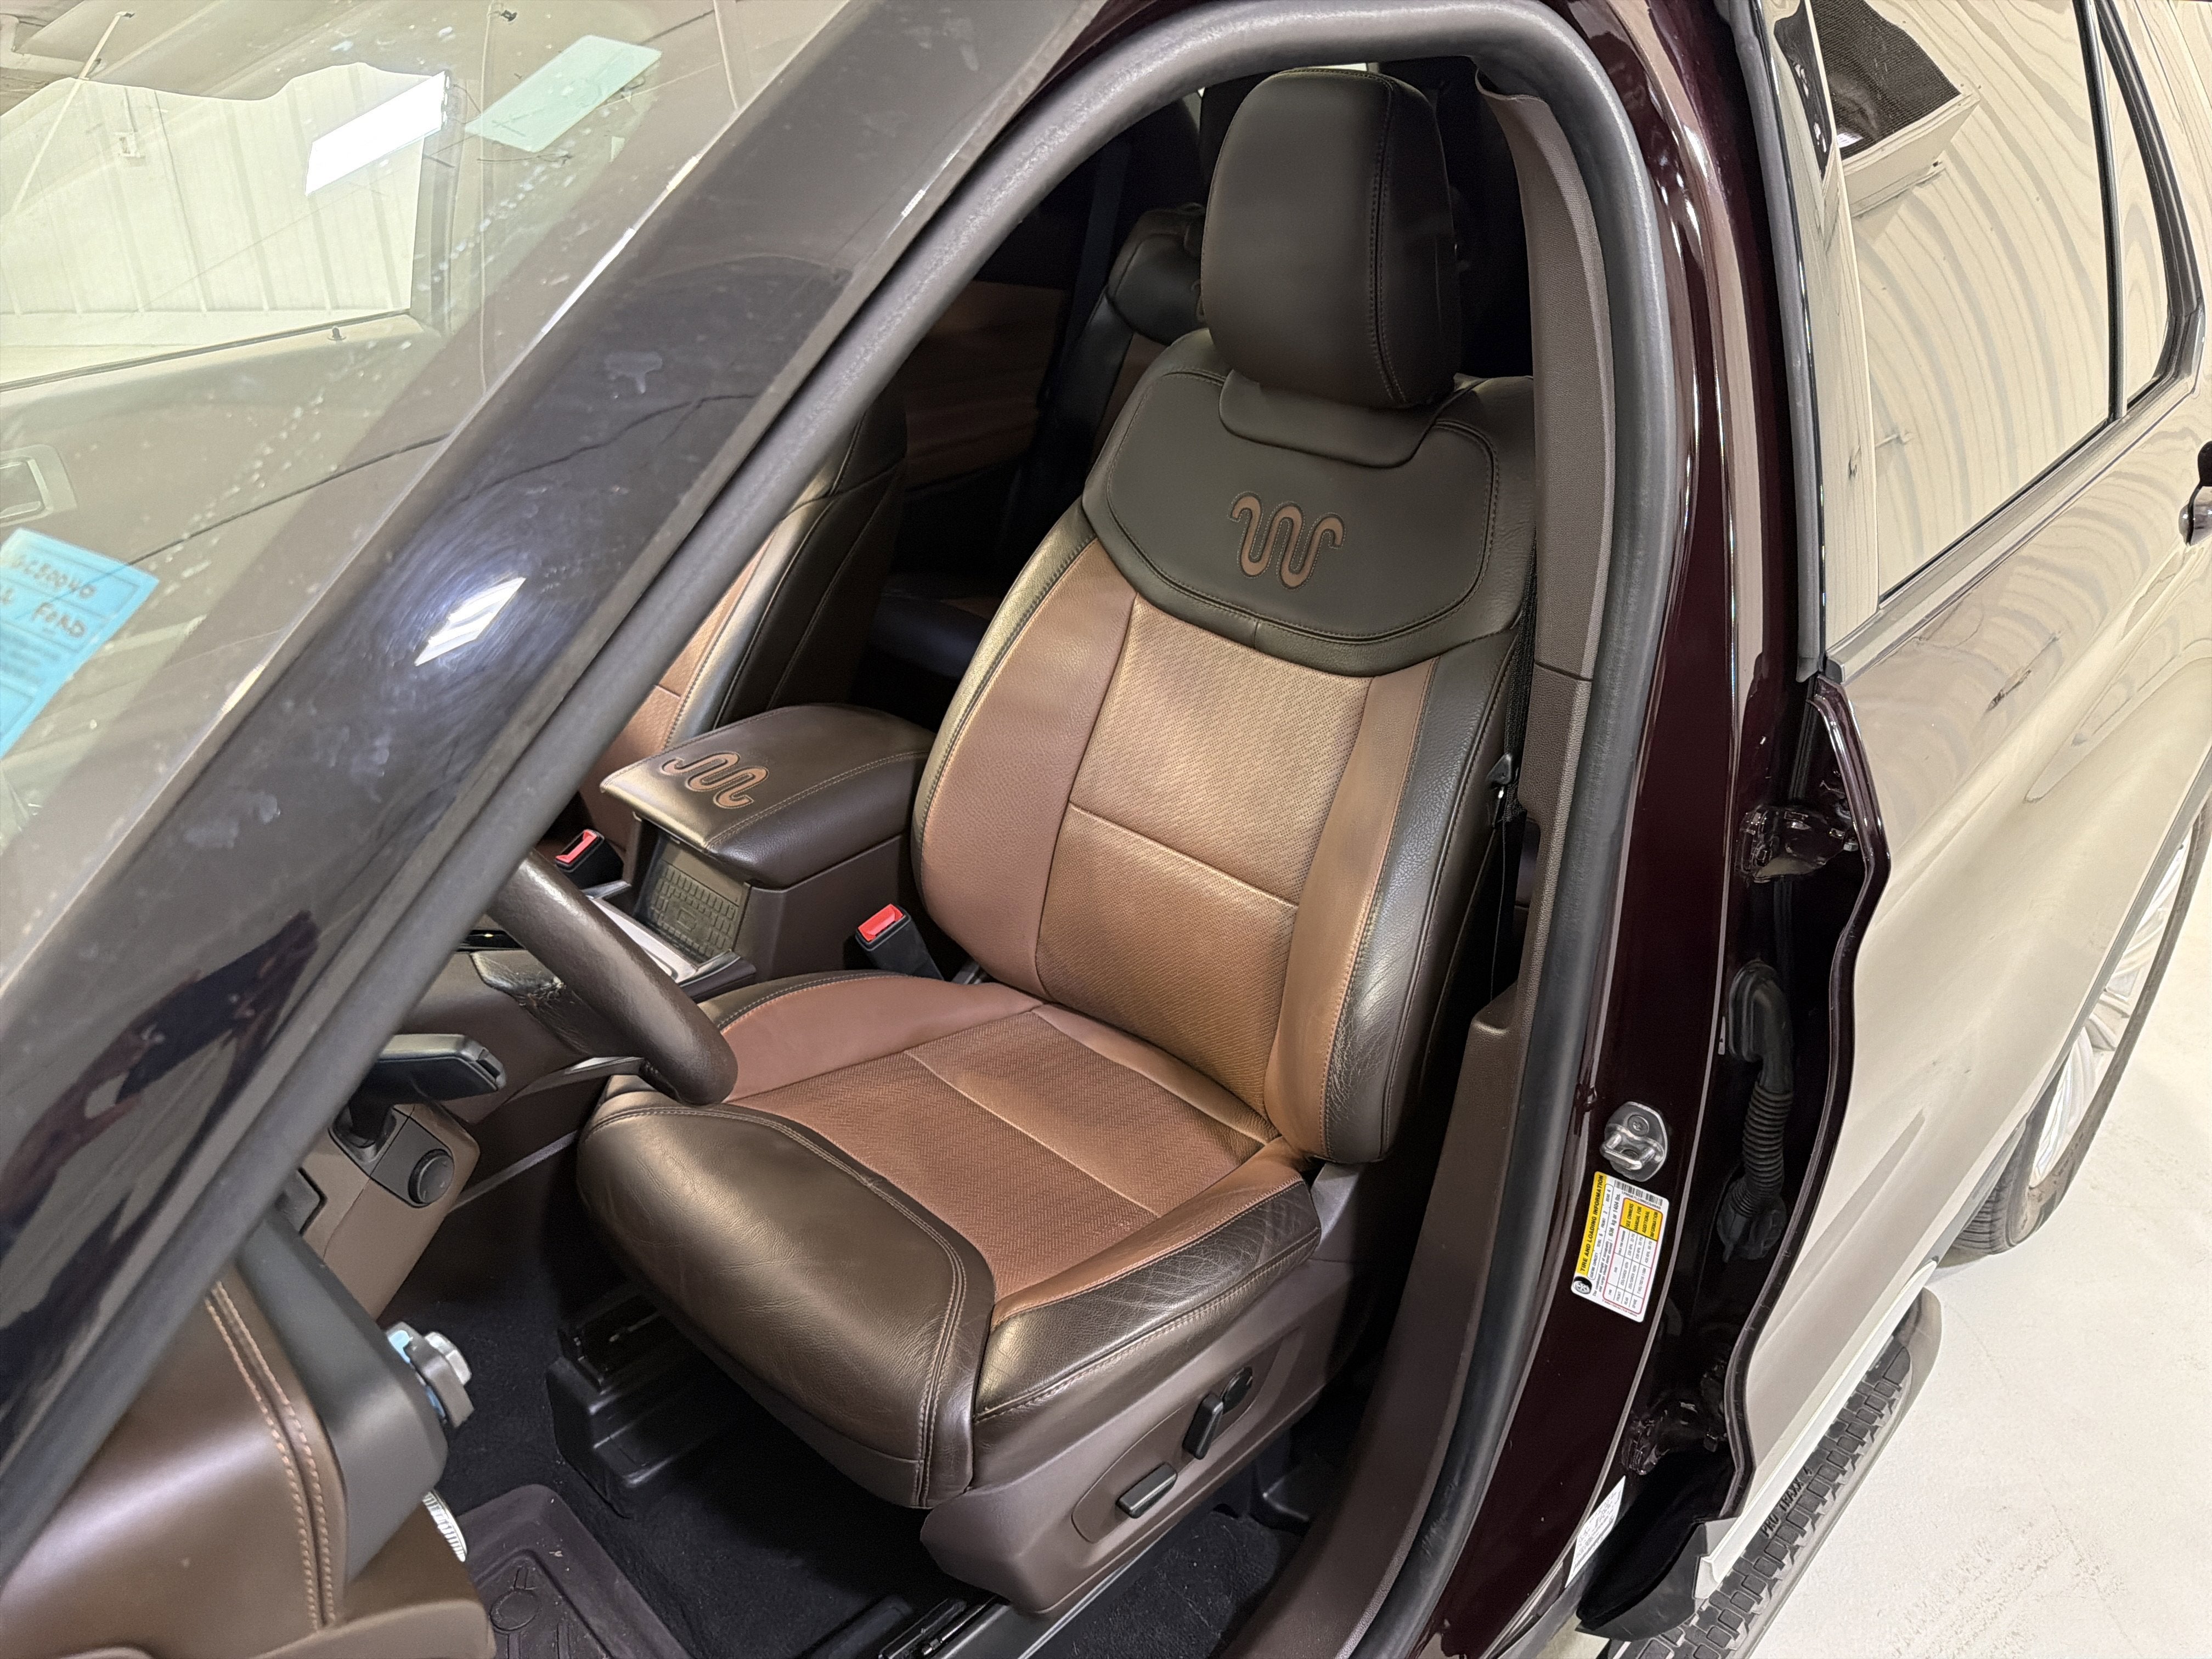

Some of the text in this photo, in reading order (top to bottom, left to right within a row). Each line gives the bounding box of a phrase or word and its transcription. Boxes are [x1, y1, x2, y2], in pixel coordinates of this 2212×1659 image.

[1586, 1214, 1597, 1243] LOADING
[1593, 1175, 1604, 1215] INFORMATION
[1610, 1218, 1617, 1226] kg
[1633, 1215, 1641, 1232] MANUAL
[1641, 1210, 1651, 1234] ADDITIONAL
[1649, 1211, 1659, 1238] INFORMATION
[1760, 1513, 1780, 1538] PRO
[1776, 1477, 1804, 1513] TRAXX
